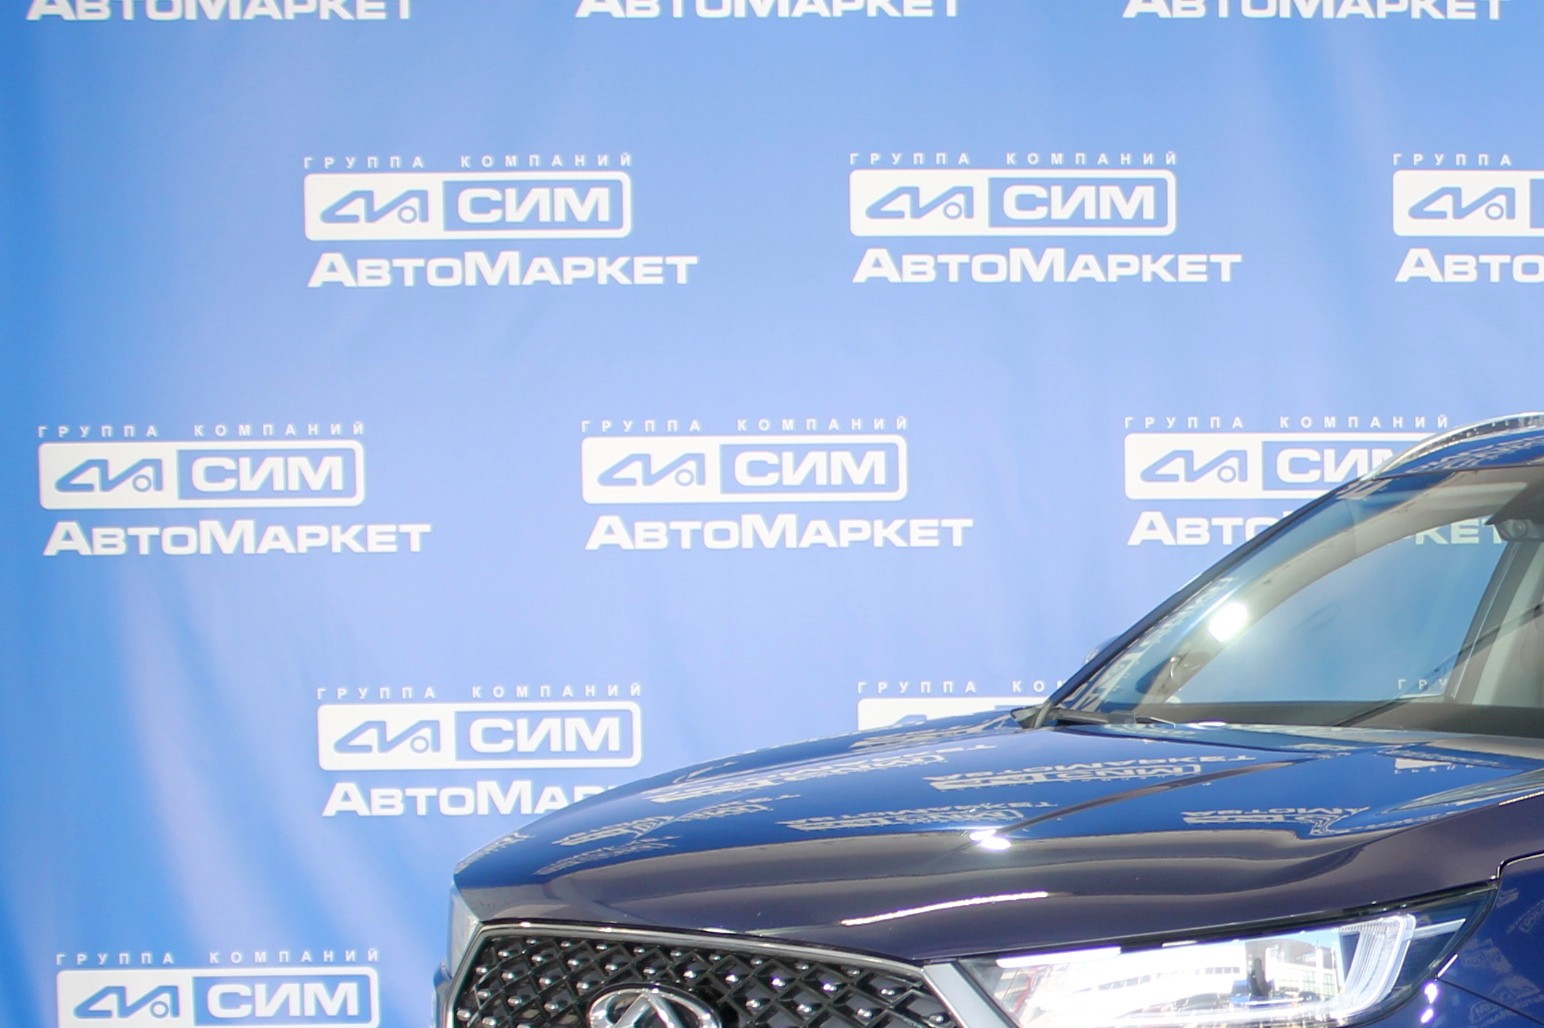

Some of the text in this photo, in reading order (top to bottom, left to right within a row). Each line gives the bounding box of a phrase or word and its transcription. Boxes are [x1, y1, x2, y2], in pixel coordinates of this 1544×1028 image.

[304, 153, 631, 168] ГРУППА КОМПАНИЙ
[850, 151, 1176, 164] ГРУППА КОМПАНИЙ
[1393, 153, 1510, 165] ГРУППА
[458, 187, 609, 222] СИМ
[1004, 185, 1154, 219] СИМ
[38, 421, 363, 436] ГРУППА КОМПАНИЙ
[582, 416, 906, 432] ГРУППА КОМПАНИЙ
[1125, 415, 1447, 428] ГРУППА КОМПАНИЙ
[192, 456, 343, 491] СИМ
[735, 451, 885, 485] СИМ
[318, 682, 640, 699] ГРУППА КОМПАНИЙ
[858, 681, 976, 693] ГРУППА
[470, 717, 619, 752] СИМ
[56, 948, 378, 965] ГРУППА КОМПАНИЙ
[208, 983, 357, 1017] СИМ
